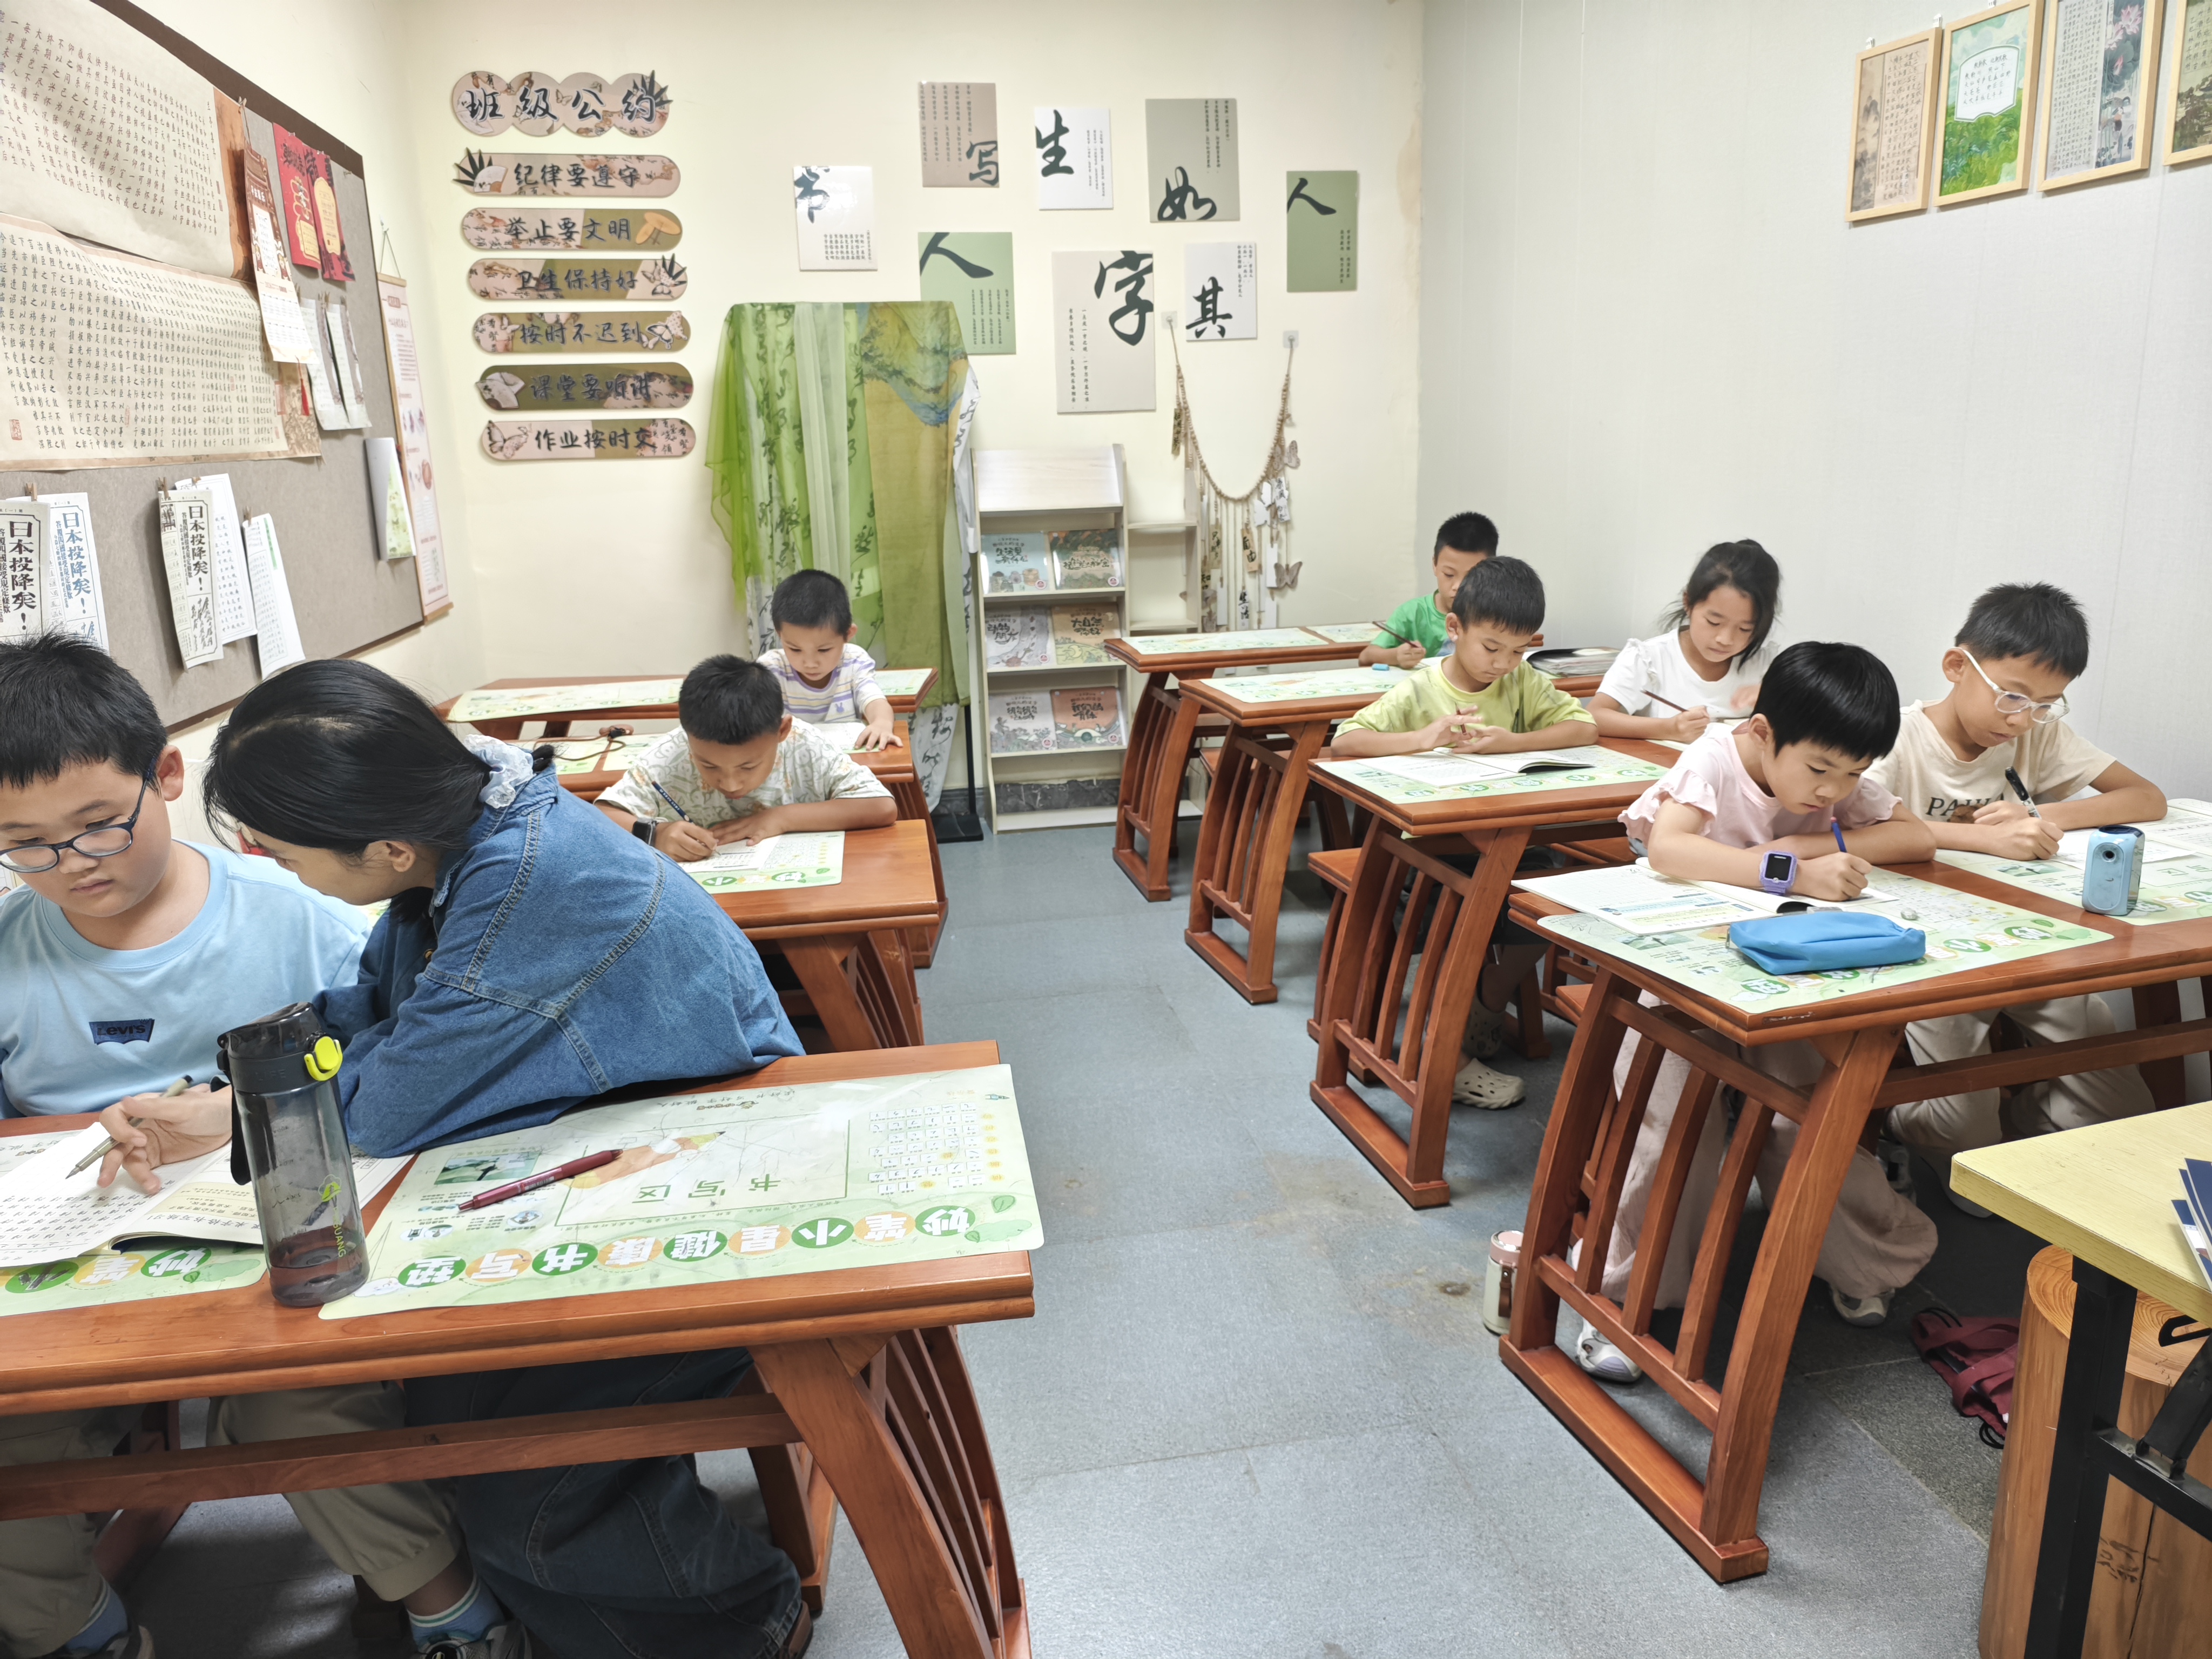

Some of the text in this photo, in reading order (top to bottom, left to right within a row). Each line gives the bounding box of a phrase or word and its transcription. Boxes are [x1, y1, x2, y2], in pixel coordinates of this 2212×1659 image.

[466, 87, 656, 123] 班级公约
[966, 141, 999, 186] 写
[1035, 109, 1075, 178] 生
[514, 164, 638, 188] 纪律要遵守
[1157, 166, 1217, 221] 如
[1286, 178, 1337, 215] 人
[505, 217, 631, 242] 举止要文明
[920, 232, 994, 279] 人
[517, 268, 637, 292] 卫生保持好
[1094, 251, 1154, 346] 字
[1185, 276, 1233, 338] 其
[520, 322, 642, 344] 按时不迟到
[531, 373, 651, 402] 课堂要听讲
[535, 429, 656, 449] 作业按时交
[63, 512, 91, 614] 日本投降矣！
[188, 505, 208, 591] 日本投降矣！
[9, 521, 37, 631] 日本投降矣！
[632, 1173, 781, 1205] 书写区
[406, 1208, 979, 1289] 妙笔小星健康书写垫
